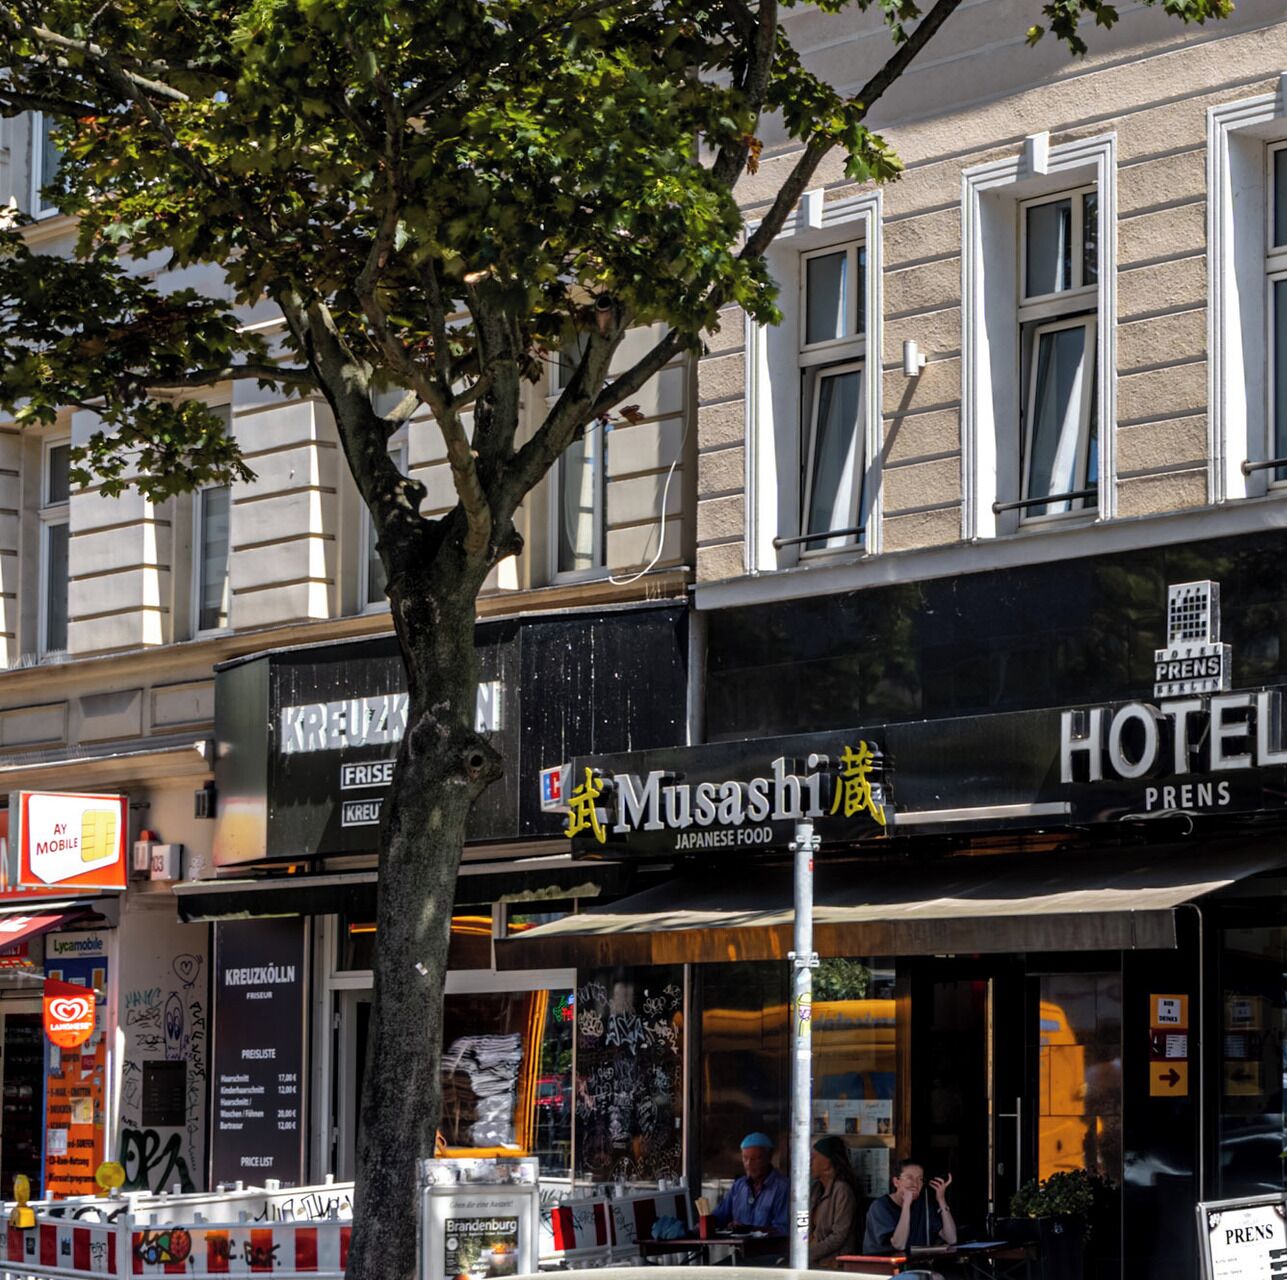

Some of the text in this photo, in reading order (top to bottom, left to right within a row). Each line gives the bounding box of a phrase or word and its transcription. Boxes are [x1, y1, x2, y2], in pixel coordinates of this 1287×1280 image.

[1156, 646, 1221, 661] HOTEL
[1156, 657, 1220, 681] PRENS
[1156, 679, 1220, 695] BERLIN
[281, 680, 502, 754] KREUZKN
[345, 766, 396, 786] FRISE
[564, 767, 607, 844] 武
[613, 753, 827, 834] Musashi
[1145, 781, 1231, 810] PRENS
[54, 824, 68, 836] AY
[675, 827, 773, 850] JAPANESE FOOD
[36, 838, 78, 855] MOBILE
[53, 935, 103, 952] Lycamobile
[225, 963, 296, 986] KREUZKÖLLN
[246, 991, 273, 1000] FRISEUR
[241, 1048, 276, 1059] PREISLISTE
[240, 1156, 275, 1167] PRICE LIST
[446, 1219, 517, 1233] Brandenburg
[1226, 1224, 1274, 1245] PRENS
